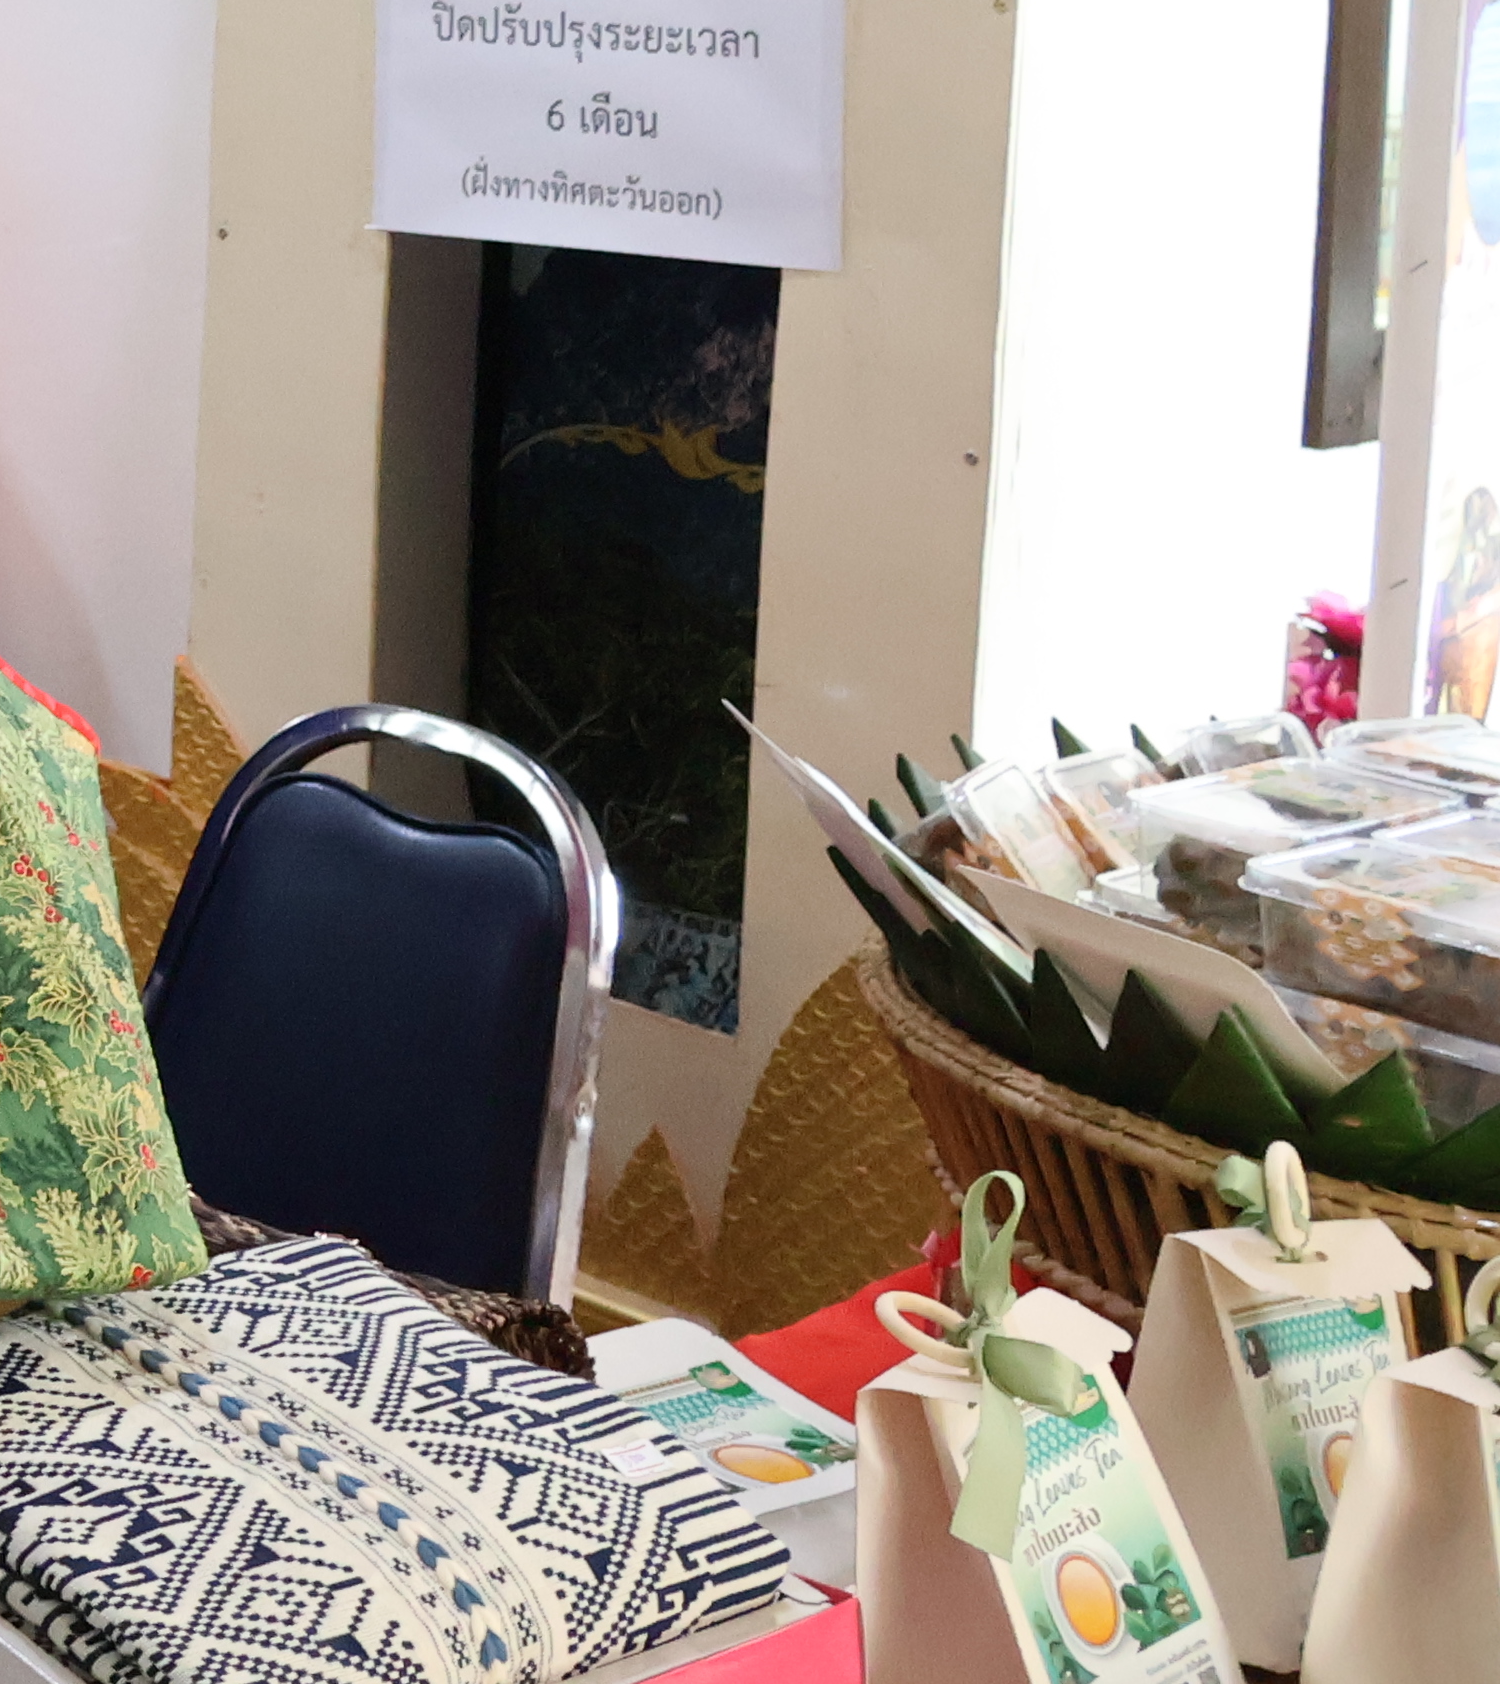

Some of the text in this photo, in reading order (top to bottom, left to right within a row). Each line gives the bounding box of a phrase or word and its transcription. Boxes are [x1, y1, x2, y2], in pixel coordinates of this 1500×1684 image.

[431, 0, 762, 65] ปิดปรับปรุงระยะเวลา
[546, 91, 659, 140] 6 เดือน
[460, 156, 724, 221] (ฝั่งทางทิศตะวันออก)
